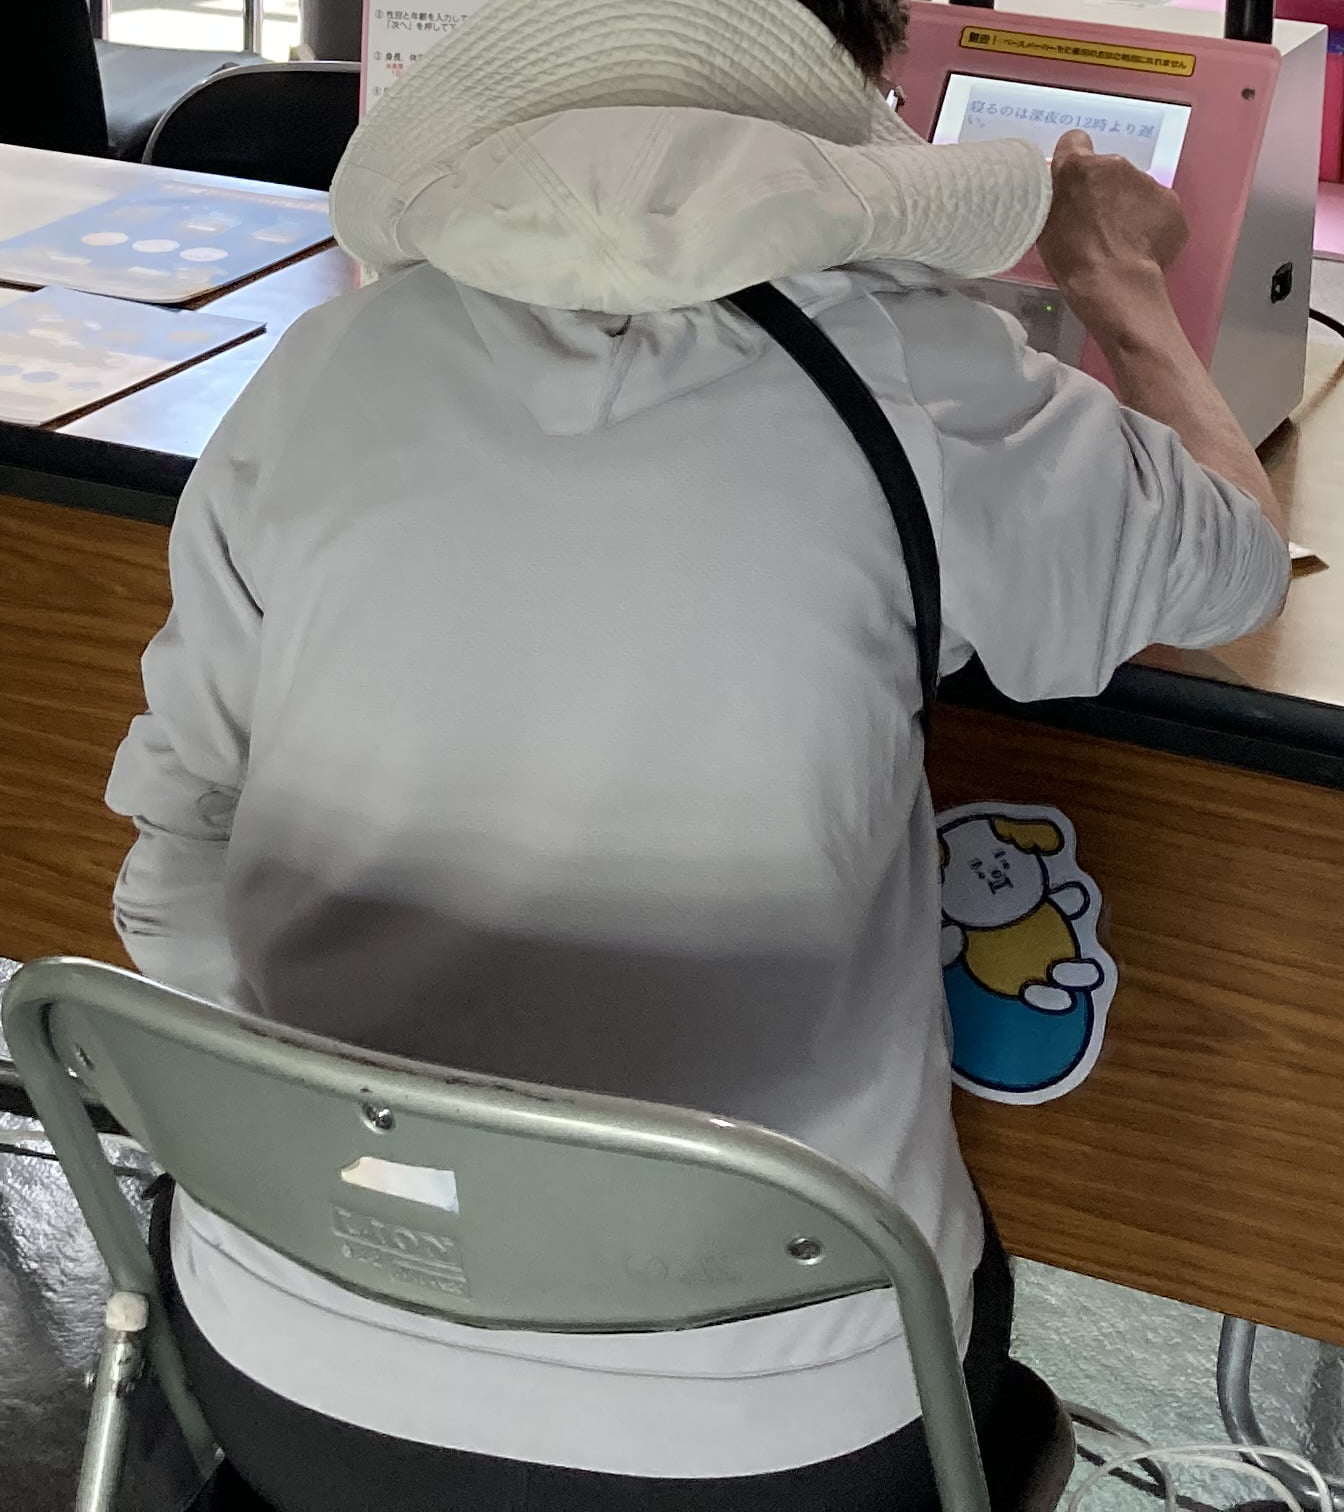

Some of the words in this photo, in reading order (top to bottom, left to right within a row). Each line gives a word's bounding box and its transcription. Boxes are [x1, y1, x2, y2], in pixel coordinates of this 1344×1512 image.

[969, 99, 1157, 138] 寝るのは深夜の12時より遅
